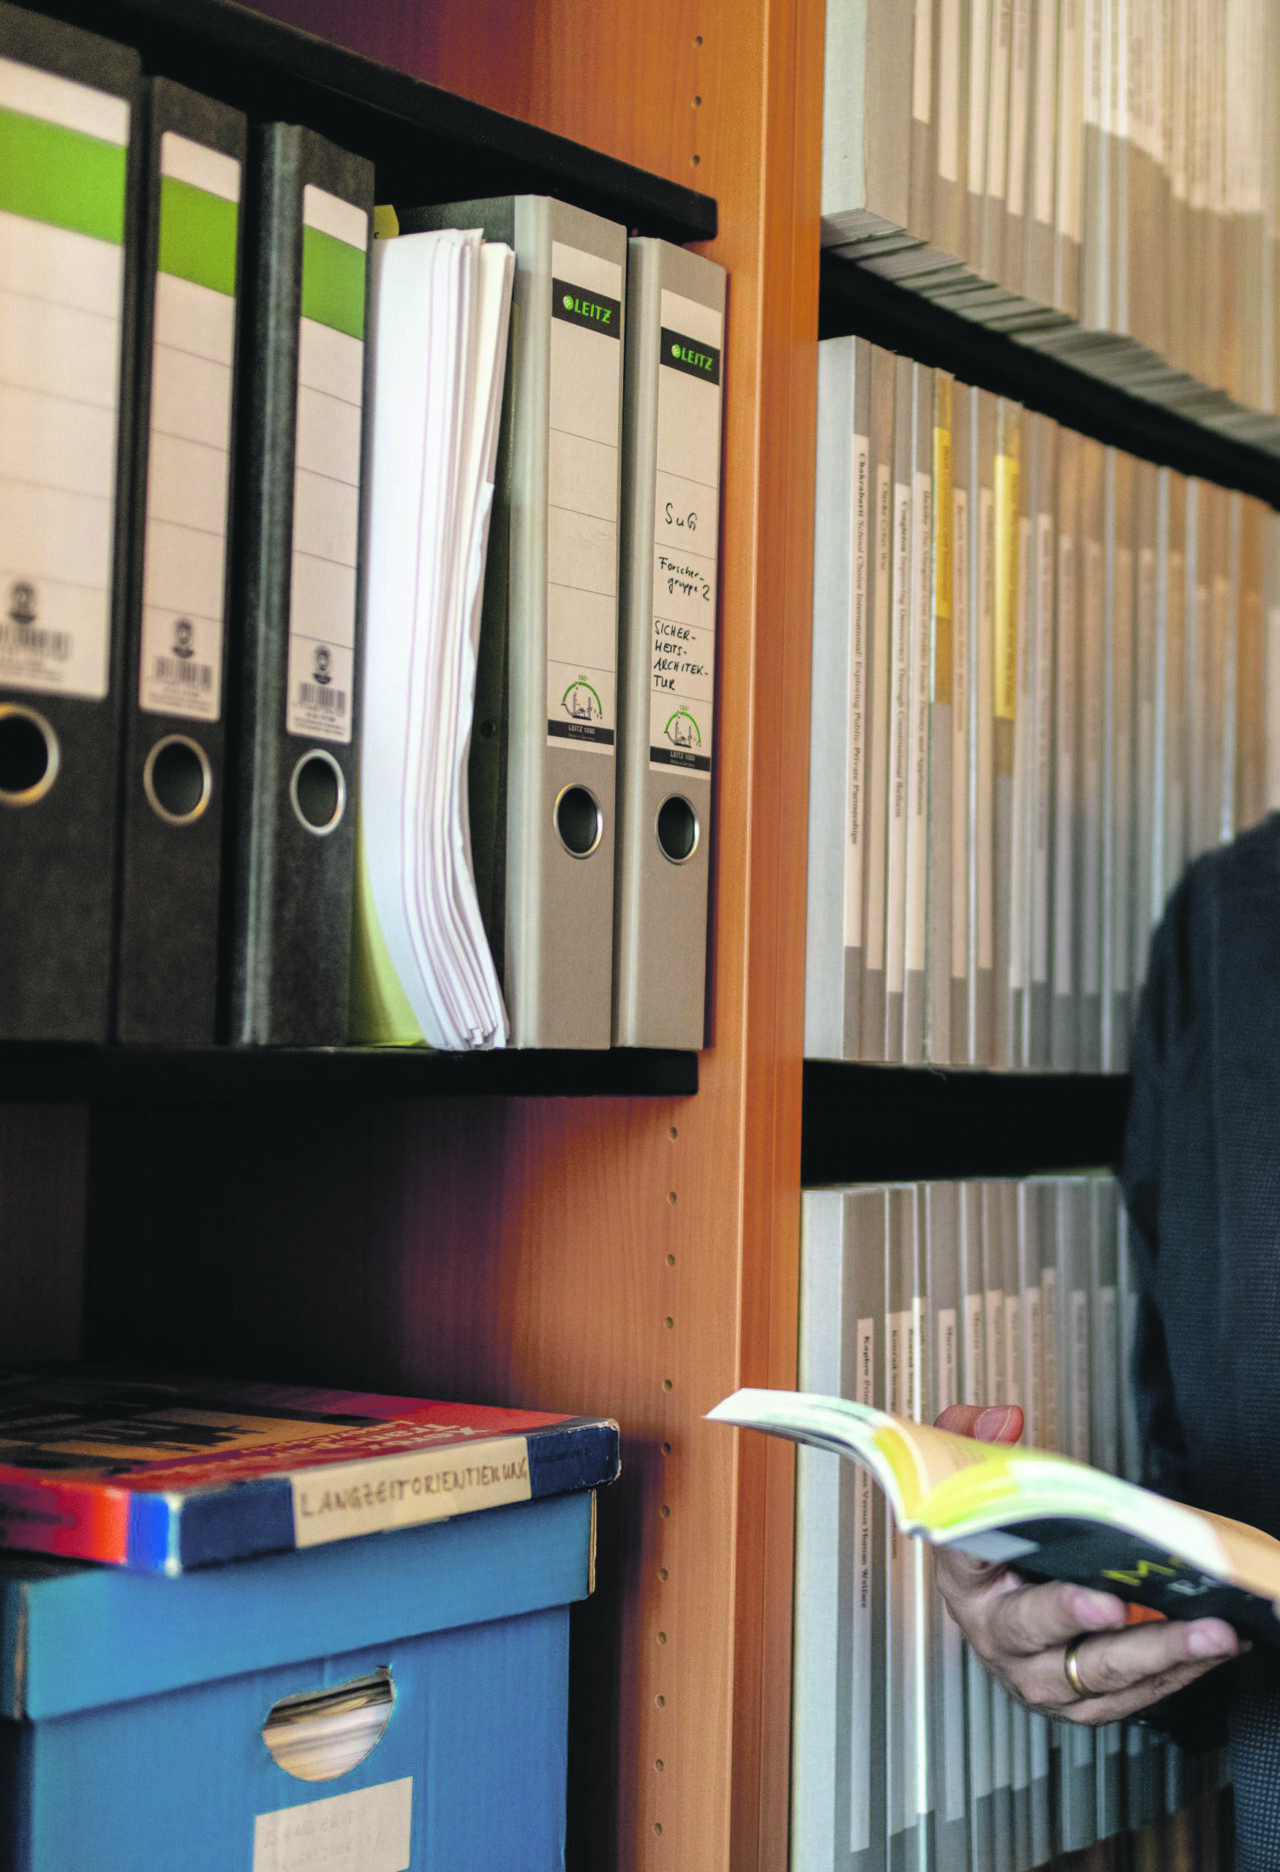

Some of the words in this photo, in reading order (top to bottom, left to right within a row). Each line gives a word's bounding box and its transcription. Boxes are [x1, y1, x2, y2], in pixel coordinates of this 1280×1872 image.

[574, 299, 612, 324] LEITZ
[681, 347, 713, 371] LEITZ
[857, 453, 867, 517] Chakrabarti
[856, 520, 865, 553] School
[899, 501, 908, 553] Congleton
[855, 556, 865, 590] Choice
[898, 556, 907, 605] Improving
[702, 584, 710, 602] 2
[655, 620, 696, 641] SICHER-
[898, 608, 906, 663] Democracy
[653, 674, 676, 691] TUR
[853, 661, 863, 709] Exploring
[897, 668, 905, 708] Through
[568, 724, 583, 733] LEITZ
[896, 711, 904, 778] Constitutional
[670, 751, 684, 759] LEITZ
[917, 756, 925, 816] Applications
[850, 784, 860, 845] Partnerships
[364, 1426, 489, 1451] Xerox
[861, 1528, 869, 1565] Human
[861, 1568, 869, 1608] Welfare
